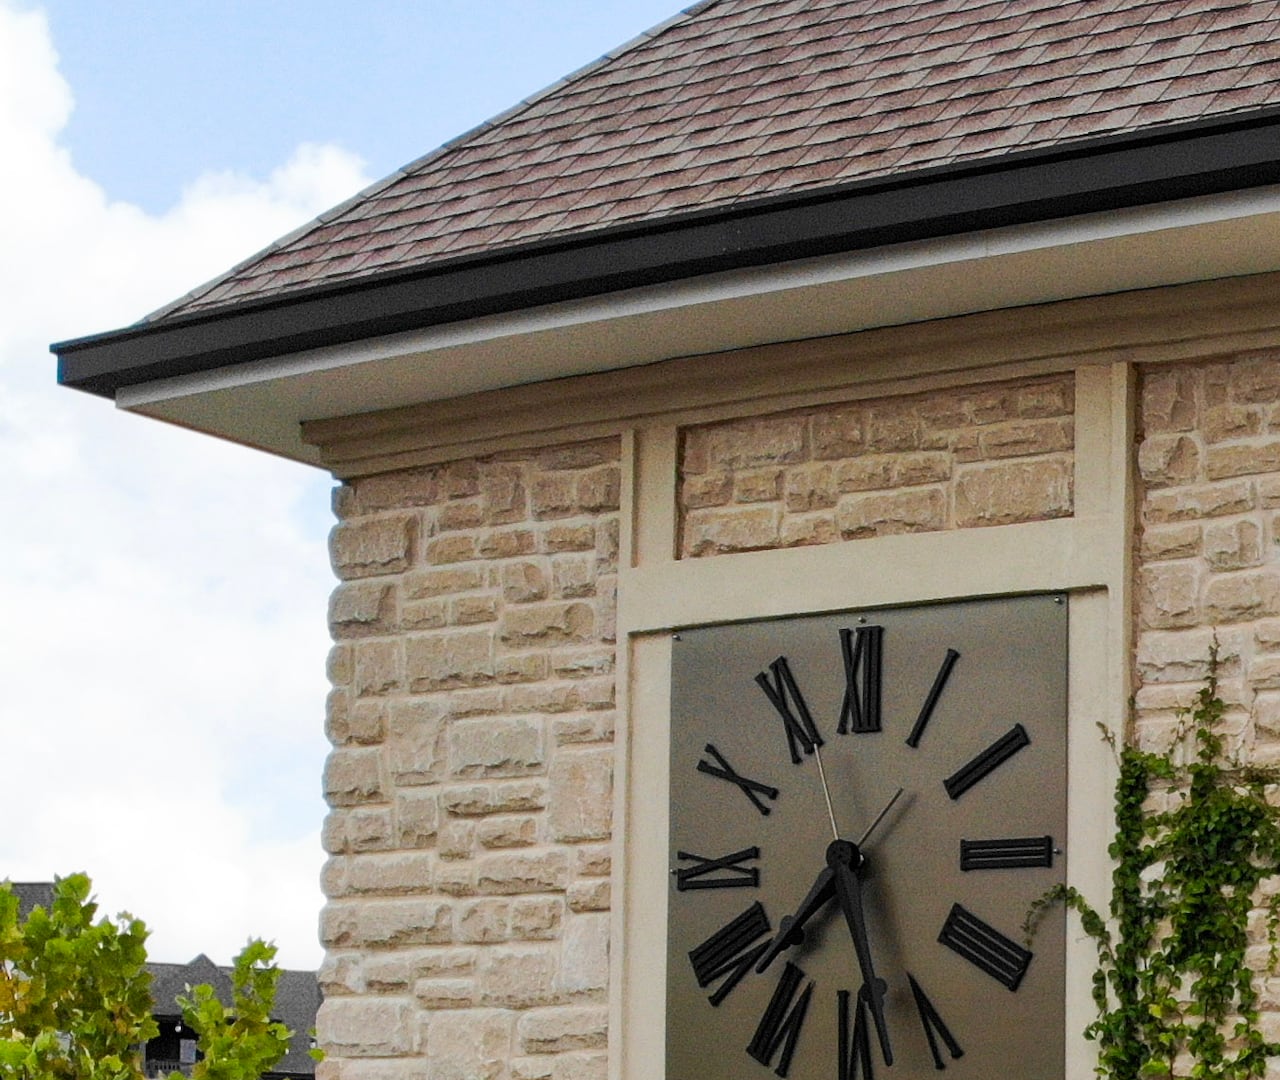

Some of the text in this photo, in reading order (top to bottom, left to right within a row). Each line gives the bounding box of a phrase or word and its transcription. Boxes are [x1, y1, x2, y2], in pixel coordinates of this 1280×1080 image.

[754, 656, 824, 765] XI
[837, 625, 884, 734] XII
[906, 648, 961, 748] I
[697, 743, 779, 816] X
[943, 723, 1031, 800] II
[677, 846, 760, 891] IX
[960, 835, 1053, 871] III
[688, 901, 777, 1007] VIII
[746, 961, 817, 1079] VII
[905, 971, 963, 1070] V
